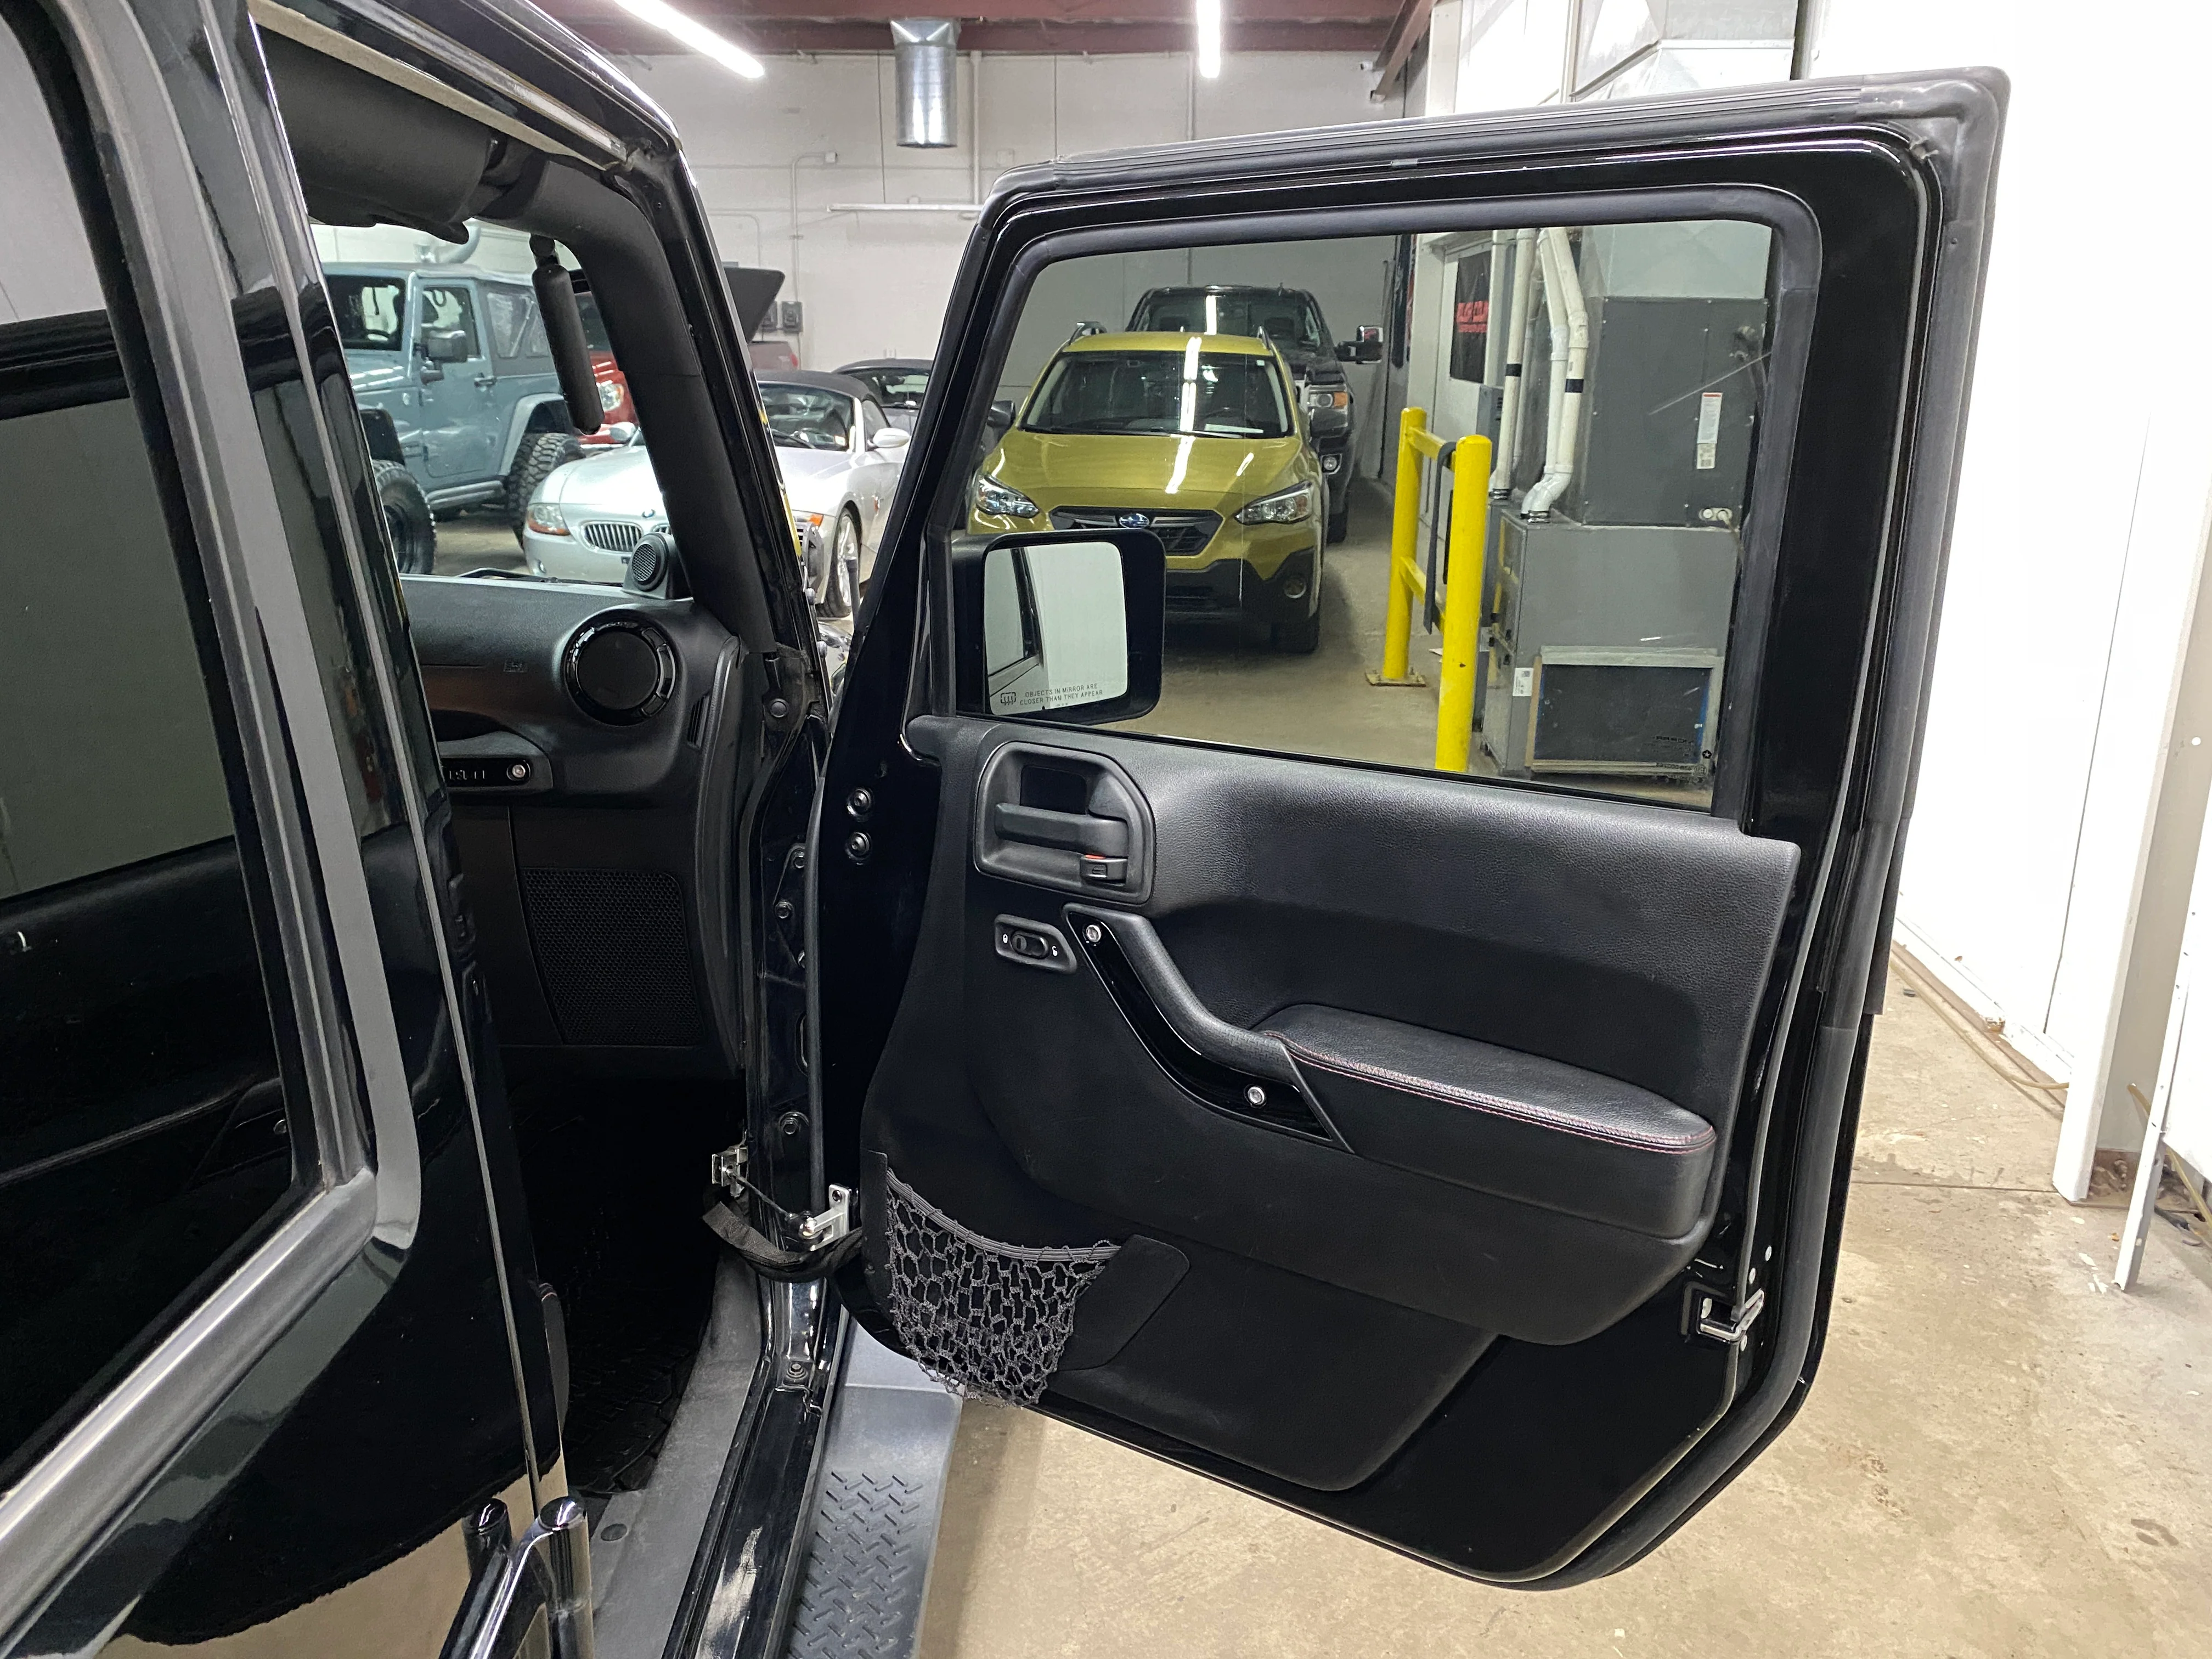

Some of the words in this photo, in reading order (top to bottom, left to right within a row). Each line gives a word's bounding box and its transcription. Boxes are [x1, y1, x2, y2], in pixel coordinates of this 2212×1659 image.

[1020, 697, 1043, 706] CLOSER
[1081, 690, 1103, 698] APPEAR
[1025, 689, 1053, 698] OBJECTS
[1062, 685, 1084, 693] MIRROR
